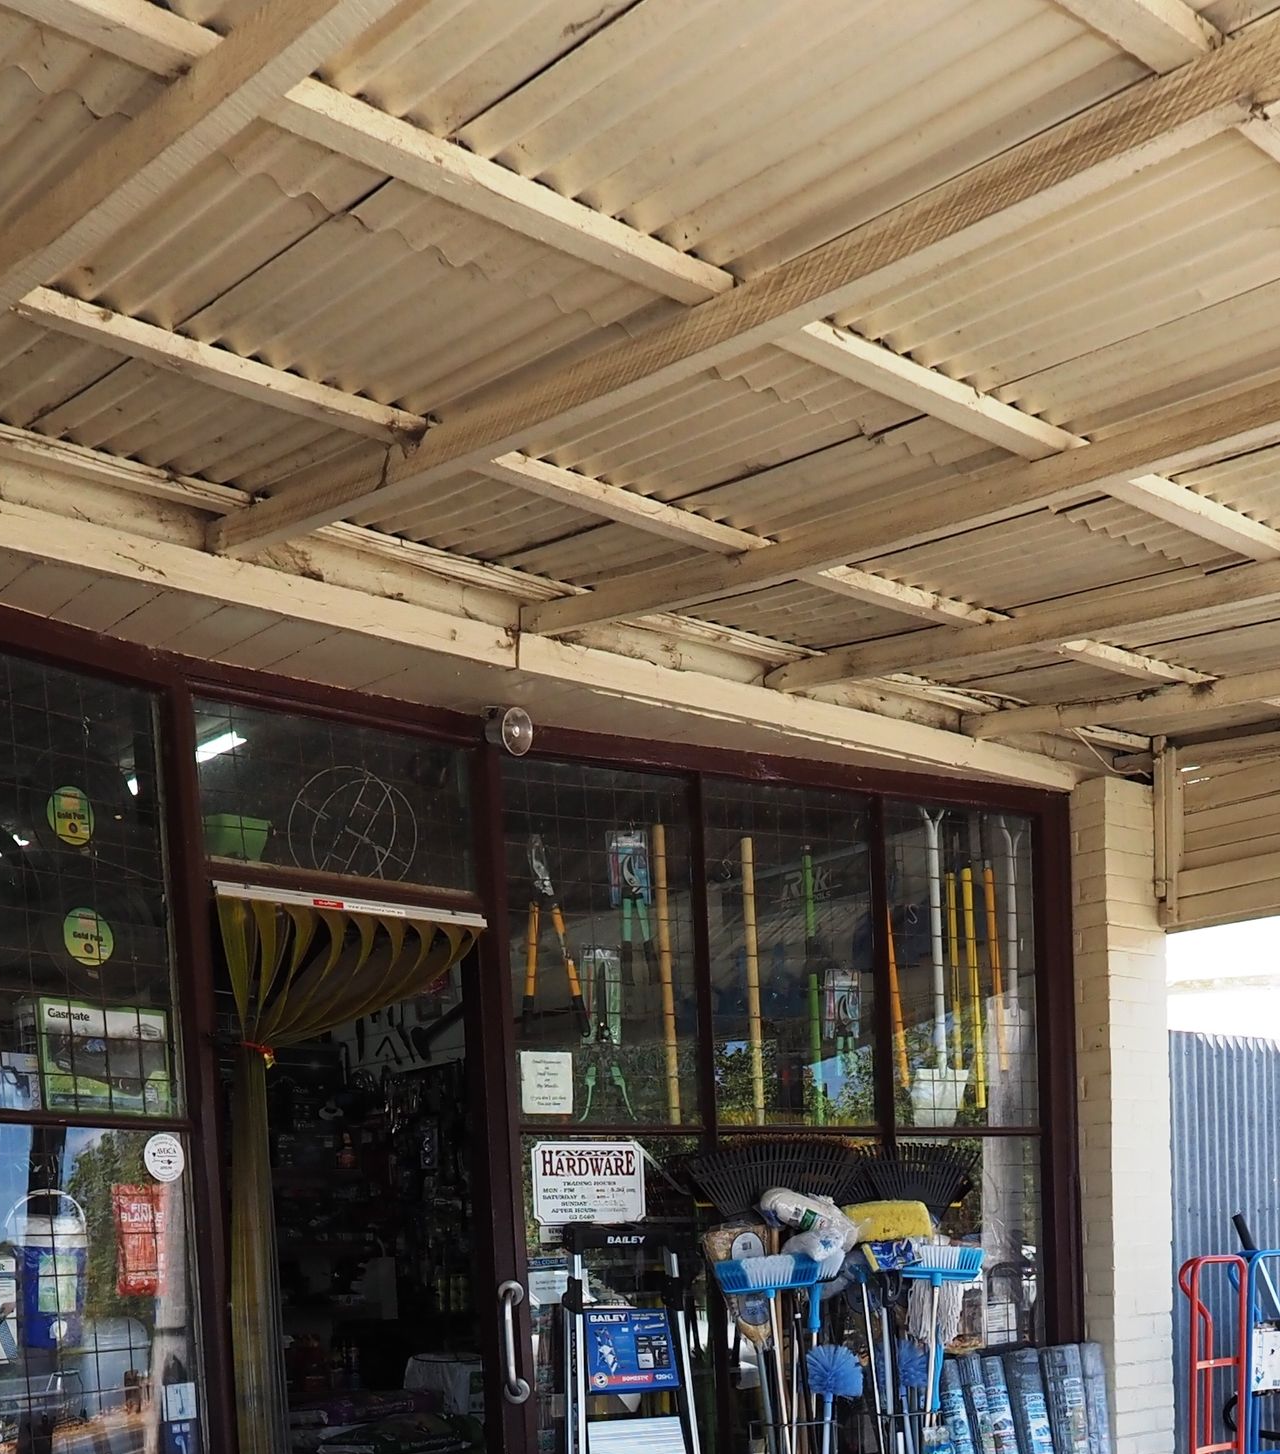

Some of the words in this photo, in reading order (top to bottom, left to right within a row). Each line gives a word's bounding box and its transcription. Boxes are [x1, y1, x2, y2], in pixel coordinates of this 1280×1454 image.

[73, 931, 89, 941] Gold
[47, 1007, 91, 1021] Gasmate
[541, 1150, 636, 1176] HARDWARE
[607, 1235, 646, 1244] BAILEY
[589, 1314, 628, 1323] BAILEY
